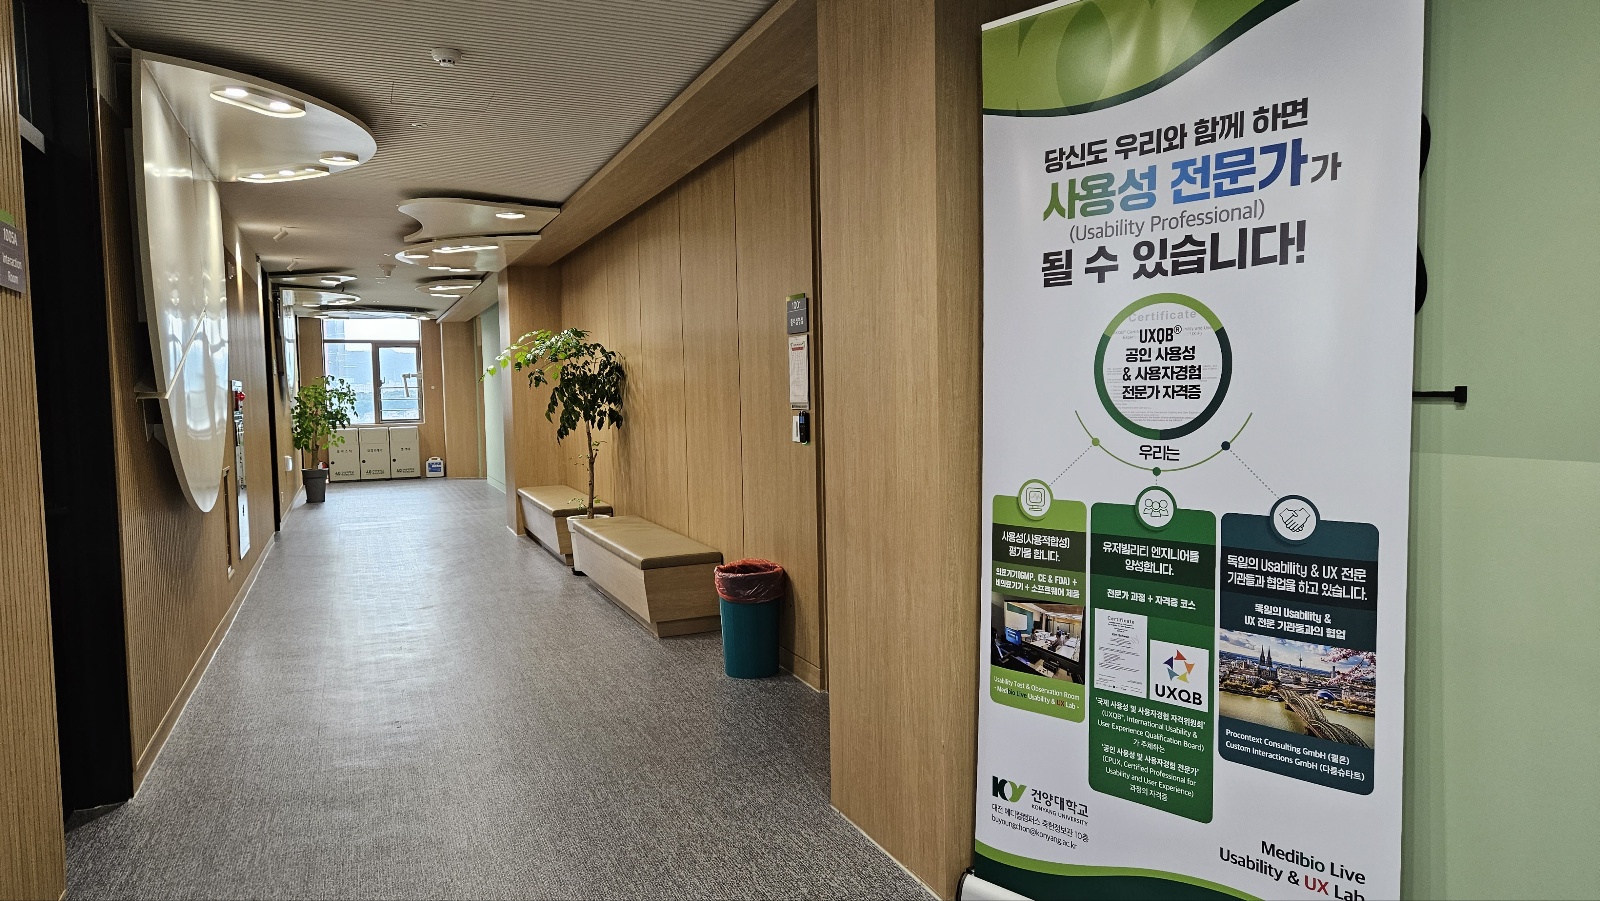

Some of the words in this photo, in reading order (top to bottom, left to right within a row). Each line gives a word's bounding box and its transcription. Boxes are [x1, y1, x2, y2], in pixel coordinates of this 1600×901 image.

[1044, 138, 1108, 174] 당신도
[1114, 125, 1188, 159] 우리와
[1194, 113, 1245, 147] 함께
[1252, 97, 1310, 135] 하면
[1042, 164, 1157, 222] 사용성
[1069, 218, 1145, 244] (Usability
[1150, 198, 1265, 234] Professional)
[1041, 249, 1073, 288] 될
[1084, 245, 1119, 284] 수
[1132, 219, 1307, 281] 있습니다!
[1129, 310, 1197, 322] Certificate
[1125, 348, 1152, 363] 공인
[1155, 345, 1196, 362] 사용성
[1122, 367, 1132, 382] &
[1134, 364, 1202, 381] 사용자경험
[1121, 385, 1161, 400] 전문가
[1162, 384, 1202, 400] 자격증
[1139, 444, 1180, 461] 우리는
[1001, 530, 1070, 549] 사용성(사용적합성)
[1008, 545, 1032, 559] 평가를
[1033, 548, 1061, 562] 합니다.
[1102, 541, 1149, 558] 유저빌리티
[1151, 545, 1200, 563] 엔지니어를
[1037, 573, 1047, 583] CE
[1125, 559, 1175, 576] 양성합니다.
[1227, 554, 1259, 571] 독일의
[1260, 558, 1308, 578] Usability
[1310, 563, 1320, 578] &
[1322, 565, 1338, 580] UX
[1340, 567, 1367, 583] 전문
[1227, 571, 1266, 588] 기관들과
[1266, 576, 1297, 593] 협업을
[1298, 580, 1319, 596] 하고
[1321, 583, 1368, 601] 있습니다.
[1106, 588, 1130, 601] 전문가
[1130, 591, 1146, 604] 과정
[1154, 595, 1178, 608] 자격증
[1179, 598, 1197, 611] 코스
[1254, 603, 1282, 617] 독일의
[1283, 607, 1322, 624] Usability
[1323, 613, 1332, 624] &
[1244, 615, 1256, 626] UX
[1257, 617, 1275, 630] 전문
[1276, 621, 1324, 637] 기관들과의
[1325, 627, 1346, 641] 협업
[1056, 699, 1065, 707] UX
[1155, 683, 1203, 706] UXQB
[1097, 719, 1111, 729] User
[1111, 722, 1144, 737] Experience
[1165, 722, 1192, 737] Usability
[1225, 728, 1263, 744] Procontext
[1263, 738, 1301, 755] Consulting
[1302, 747, 1327, 760] GmbH
[1225, 740, 1251, 754] Custom
[1252, 747, 1294, 764] Interactions
[1294, 758, 1318, 770] GmbH
[1131, 774, 1143, 783] and
[1143, 777, 1158, 787] User
[1158, 781, 1195, 798] Experience)
[1149, 767, 1186, 784] Professional
[1031, 788, 1089, 818] 건양대학교
[1219, 846, 1284, 882] Usability
[1287, 870, 1300, 886] &
[1304, 874, 1329, 896] UX
[1334, 884, 1365, 901] Lab
[1261, 840, 1325, 873] Medibio
[1330, 861, 1366, 885] Live
